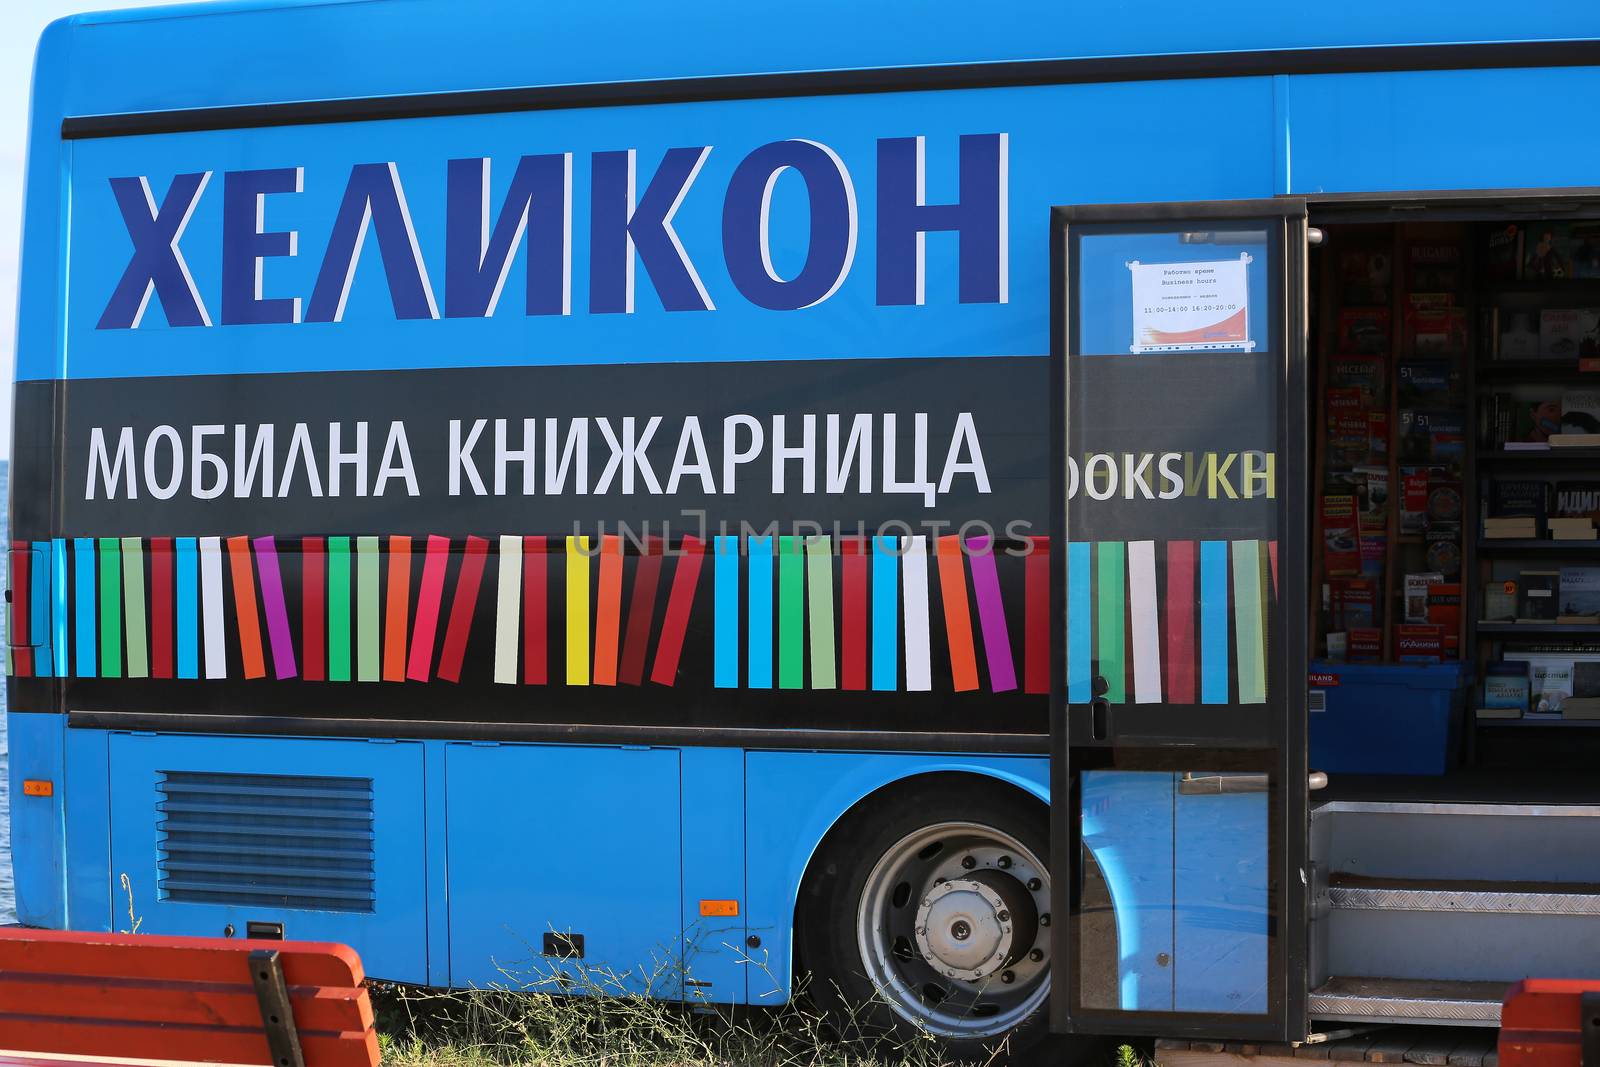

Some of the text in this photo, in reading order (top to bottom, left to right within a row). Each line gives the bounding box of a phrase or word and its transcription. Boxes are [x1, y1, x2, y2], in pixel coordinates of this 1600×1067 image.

[96, 132, 1010, 331] ХЕЛИКОН
[1144, 306, 1188, 314] 11:00-14:00
[1400, 367, 1412, 378] 51
[1417, 415, 1430, 427] 51
[85, 411, 992, 508] МОБИЛНА КНИЖАРНИЦА
